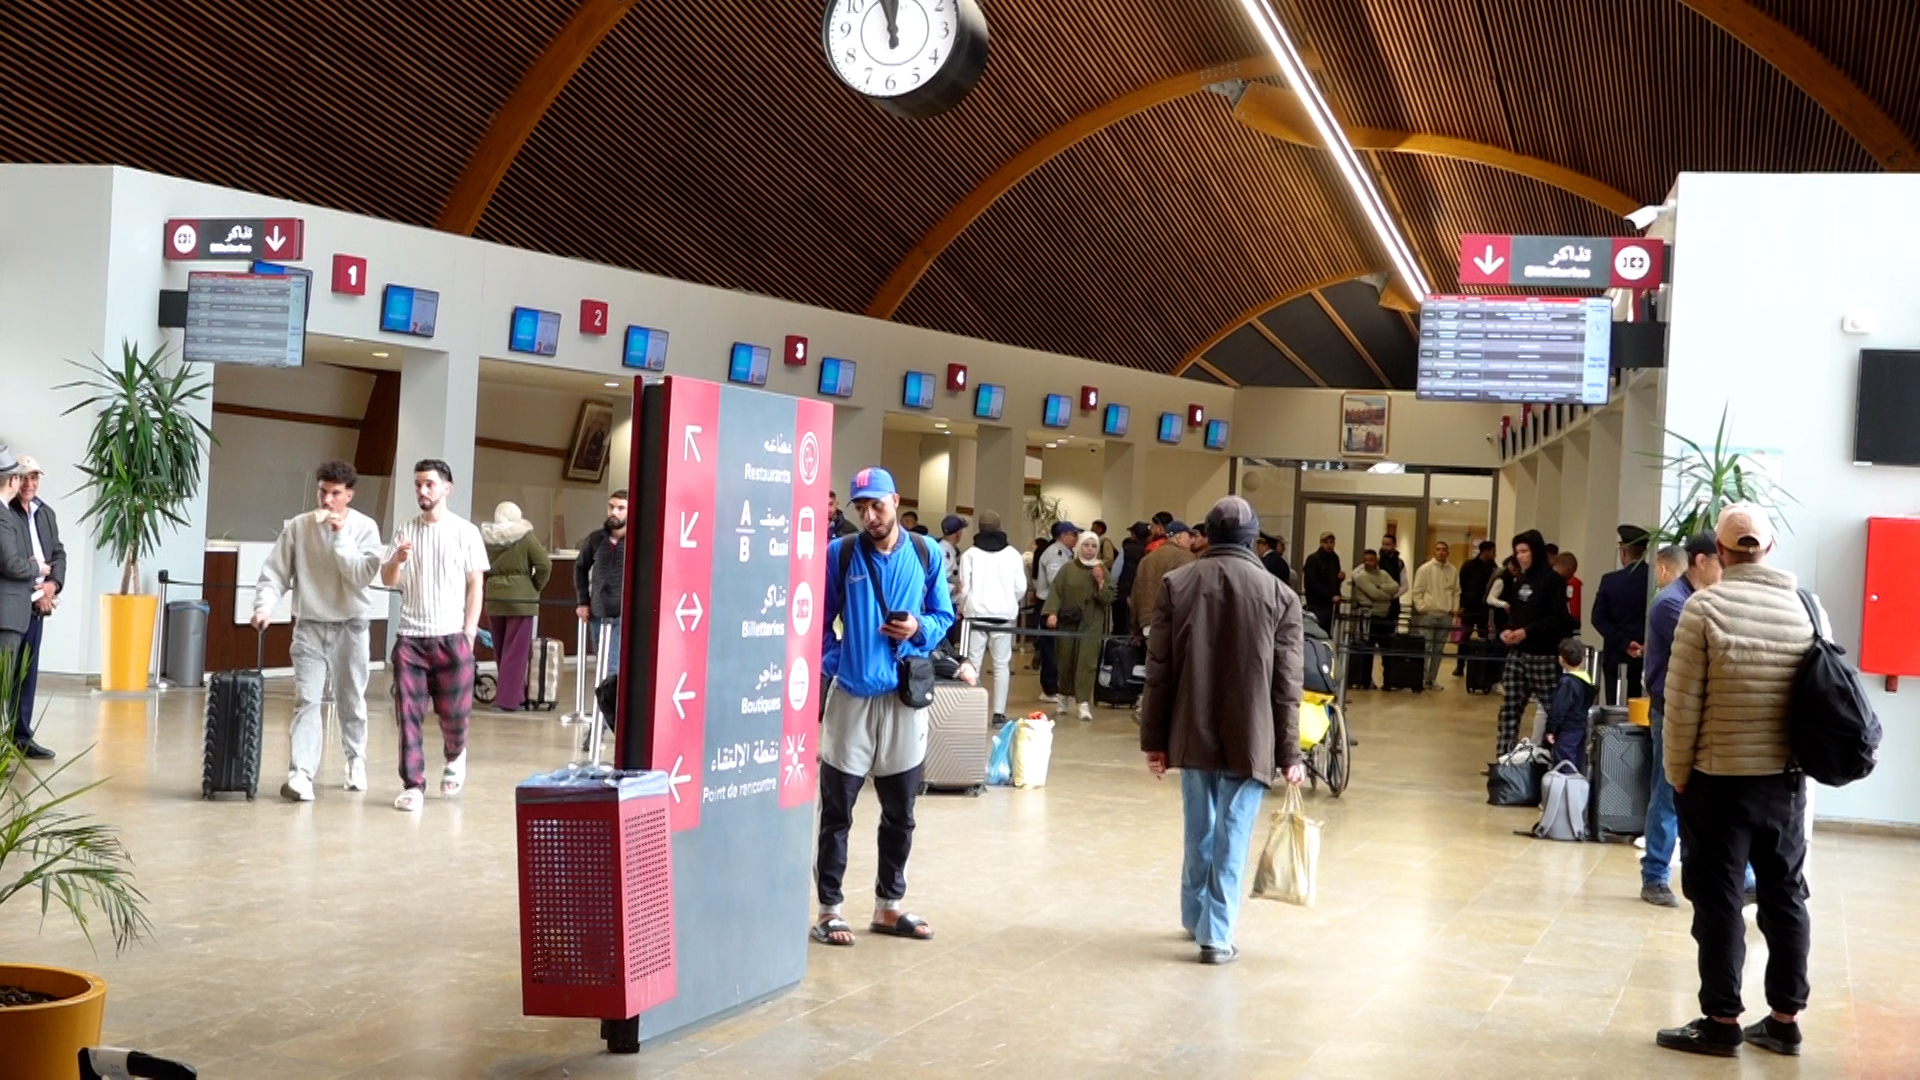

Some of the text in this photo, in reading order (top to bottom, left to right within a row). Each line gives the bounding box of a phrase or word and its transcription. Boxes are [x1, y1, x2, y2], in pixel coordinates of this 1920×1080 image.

[846, 0, 864, 14] 10
[840, 21, 852, 39] 9
[939, 21, 950, 39] 3
[845, 47, 857, 64] 8
[928, 48, 939, 65] 4
[864, 67, 874, 85] 7
[884, 74, 896, 90] 6
[911, 67, 921, 84] 5
[1547, 245, 1591, 266] تذاكر
[348, 265, 357, 286] 1
[594, 309, 602, 326] 2
[795, 342, 804, 359] 3
[744, 463, 791, 484] Restaurants
[740, 499, 752, 526] A
[759, 507, 789, 534] رصيف
[739, 535, 750, 562] B
[769, 537, 789, 556] Quai
[760, 584, 786, 614] تذاكر
[741, 620, 785, 637] Billetteries
[755, 661, 782, 690] متاجر
[741, 695, 781, 716] Boutiques
[752, 739, 779, 764] نقطة
[702, 777, 777, 804] Point de rencontre
